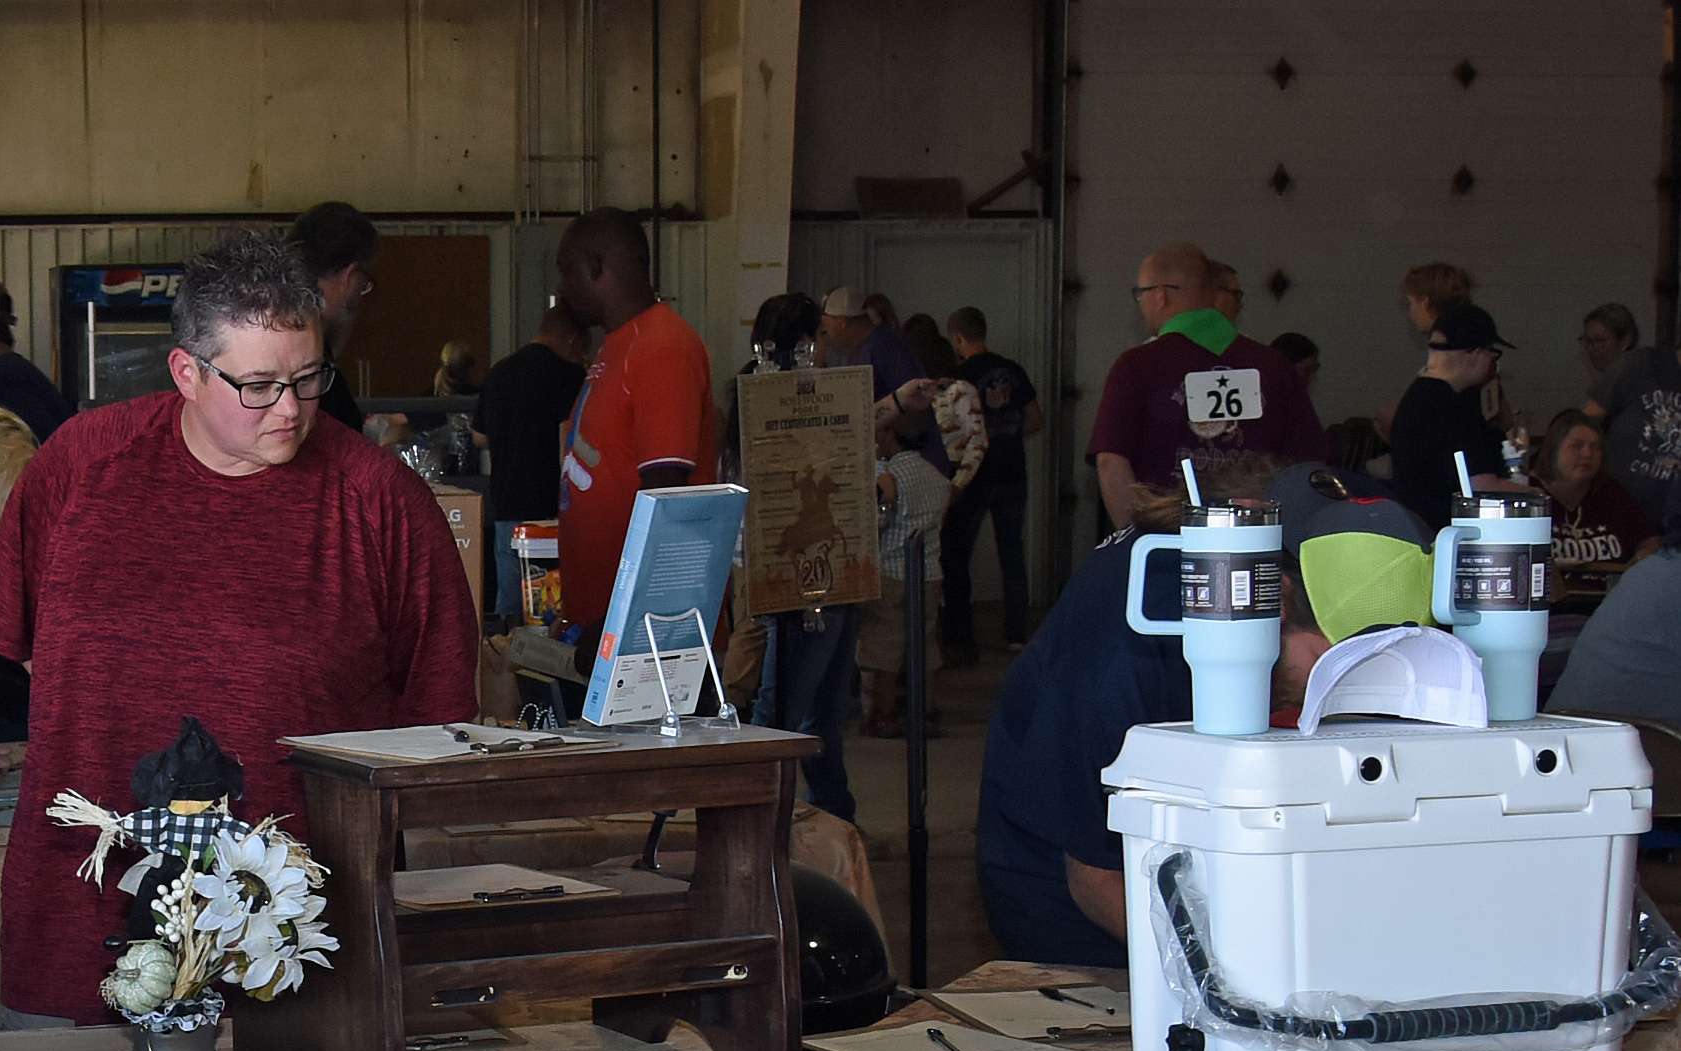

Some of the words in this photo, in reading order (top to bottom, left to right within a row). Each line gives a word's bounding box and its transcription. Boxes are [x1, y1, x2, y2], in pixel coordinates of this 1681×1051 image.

[1206, 388, 1243, 419] 26
[448, 509, 462, 522] G
[1550, 534, 1622, 563] RODEO
